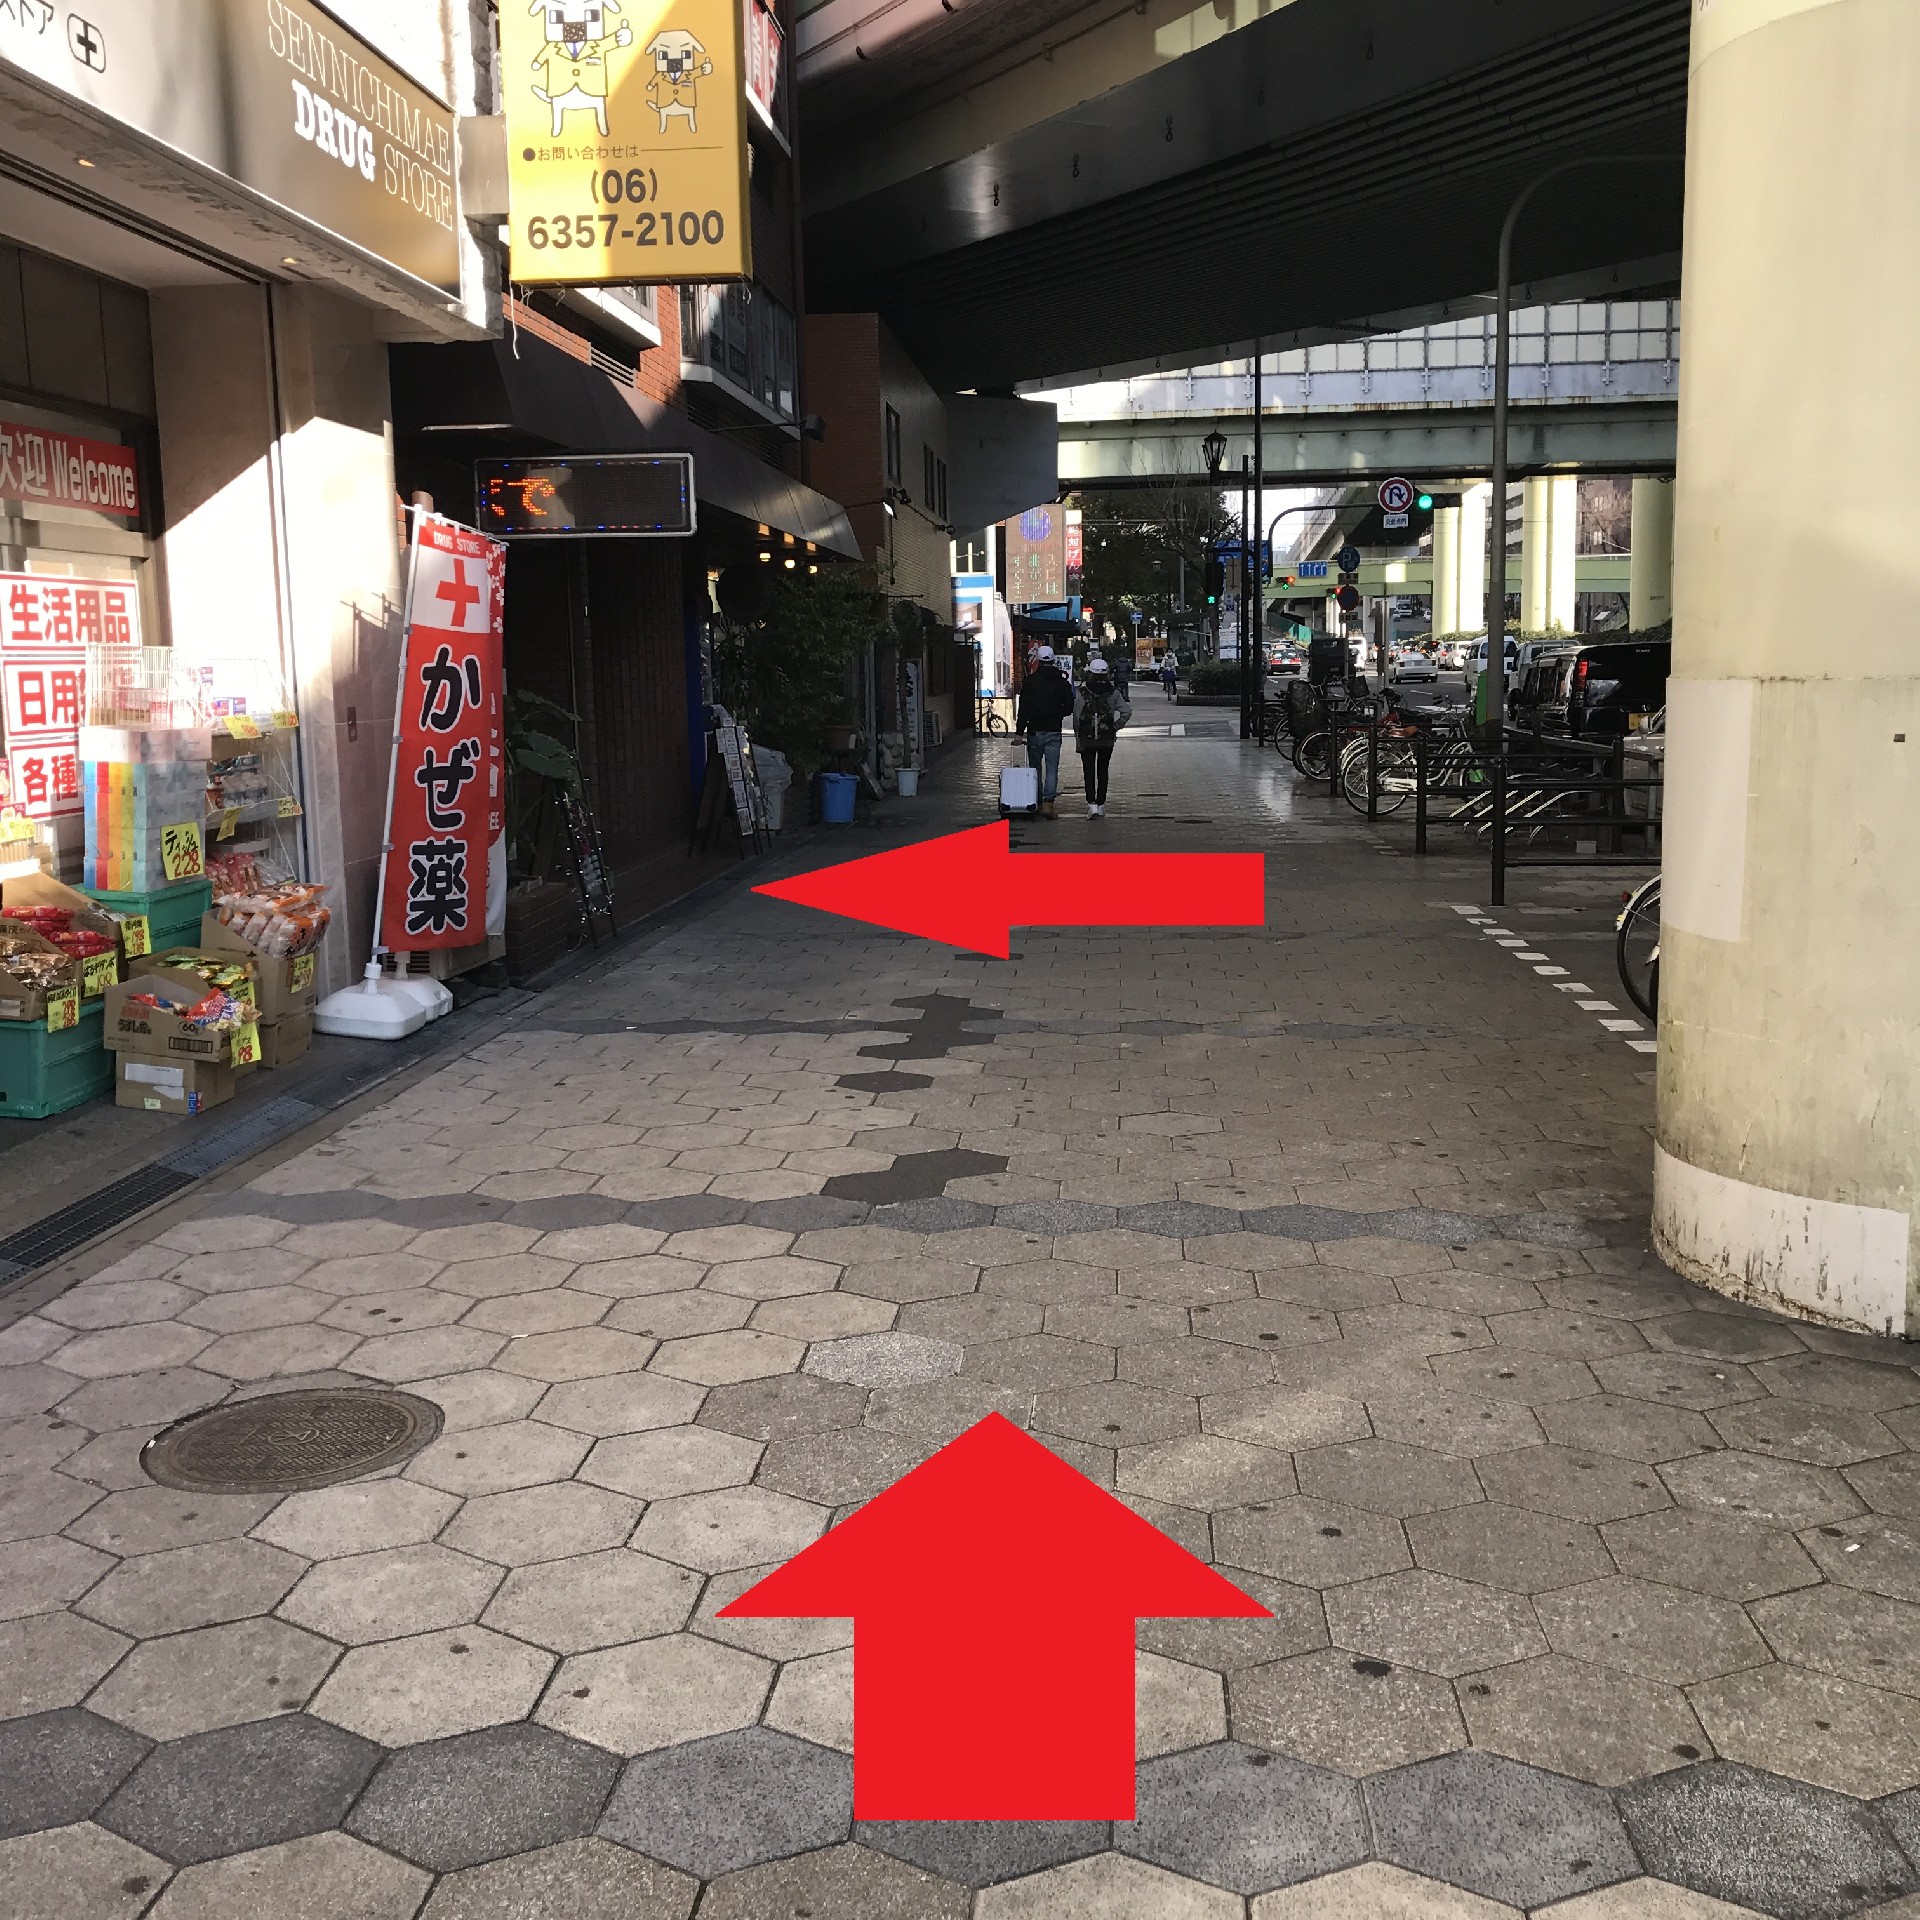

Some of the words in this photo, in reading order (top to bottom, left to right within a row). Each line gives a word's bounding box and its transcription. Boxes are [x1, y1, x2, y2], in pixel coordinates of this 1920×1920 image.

[268, 0, 451, 176] SENNICHIMAE
[292, 79, 376, 182] DRUG
[384, 143, 453, 231] STORE
[538, 144, 639, 161] お問い合わせは
[591, 168, 658, 204] (06)
[528, 210, 724, 250] 6357-2100
[49, 439, 135, 508] Welcome
[434, 531, 453, 550] DRUG
[456, 537, 481, 554] STORE
[9, 584, 130, 643] 生活用品
[22, 753, 78, 804] 各種
[405, 644, 482, 935] かぜ薬
[172, 850, 201, 877] 228
